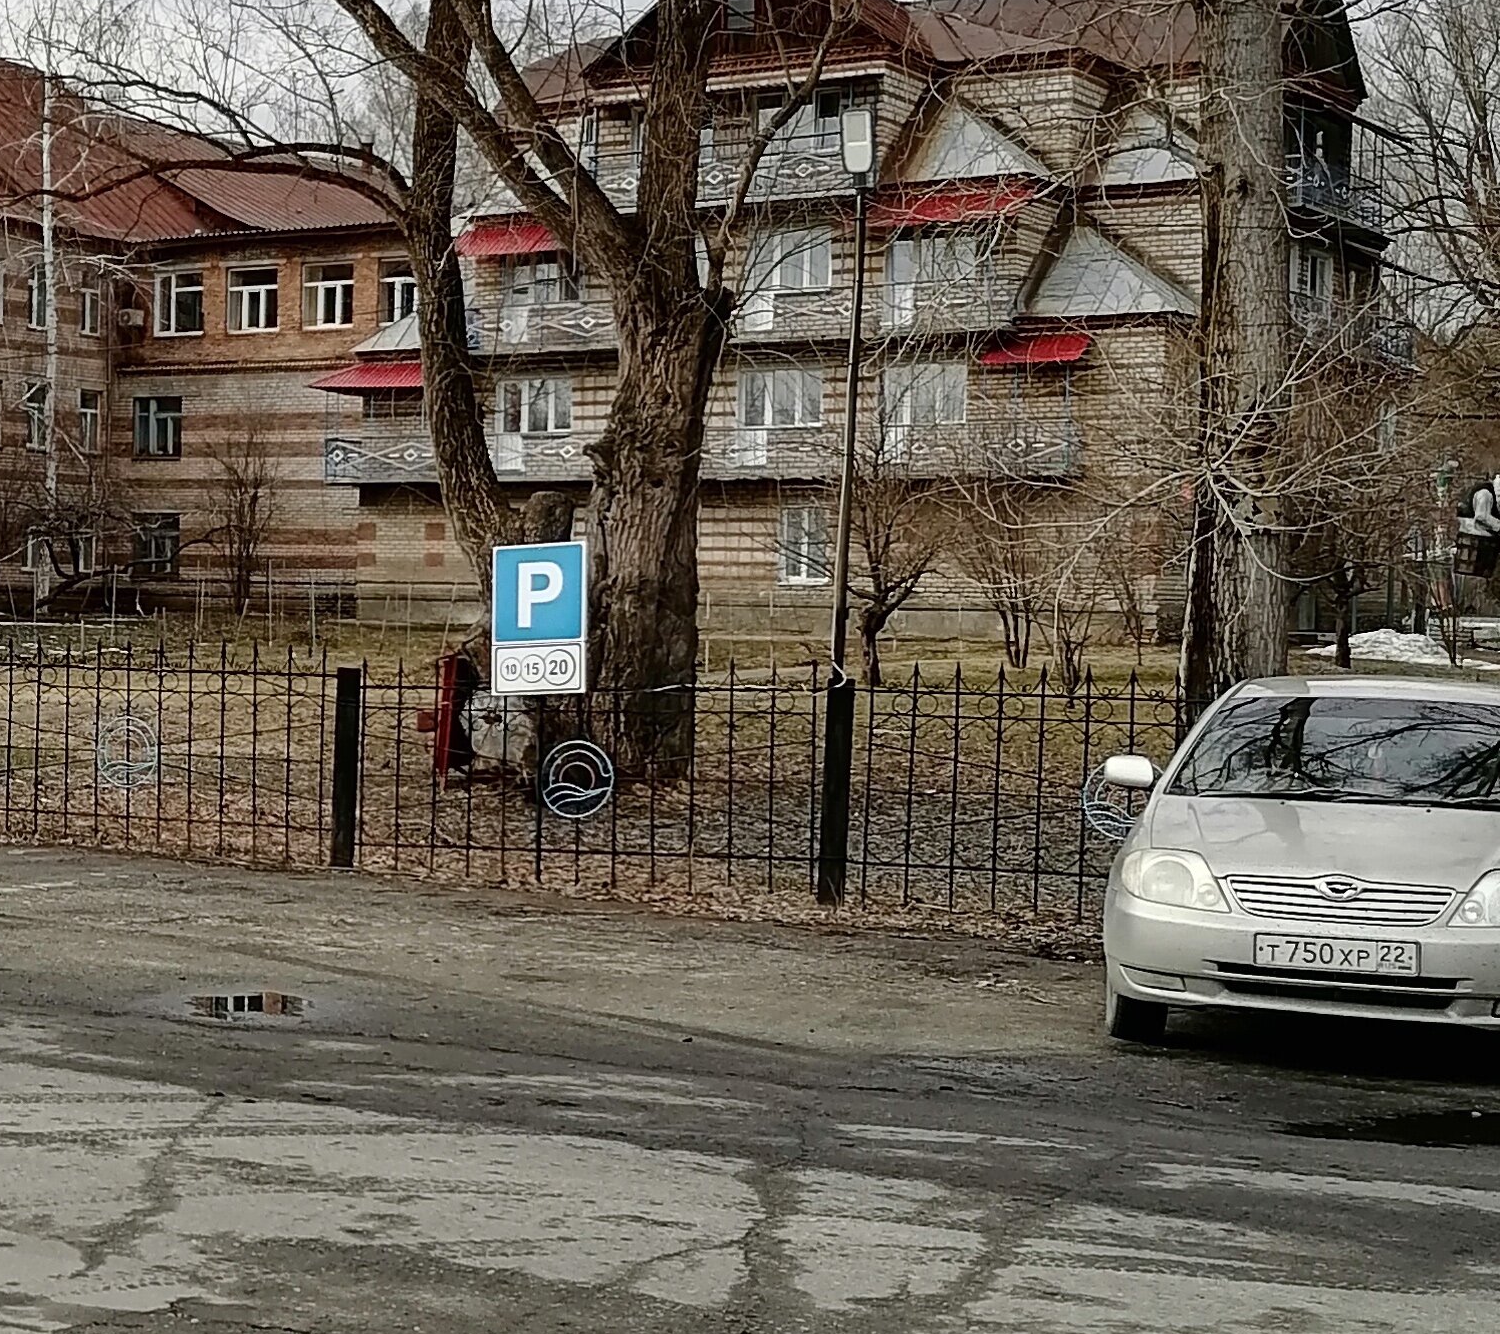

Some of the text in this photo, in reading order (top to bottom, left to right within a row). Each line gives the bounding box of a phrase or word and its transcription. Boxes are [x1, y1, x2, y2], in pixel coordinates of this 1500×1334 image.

[517, 561, 564, 628] P
[505, 660, 569, 676] 10 15 20
[1380, 945, 1405, 963] 22
